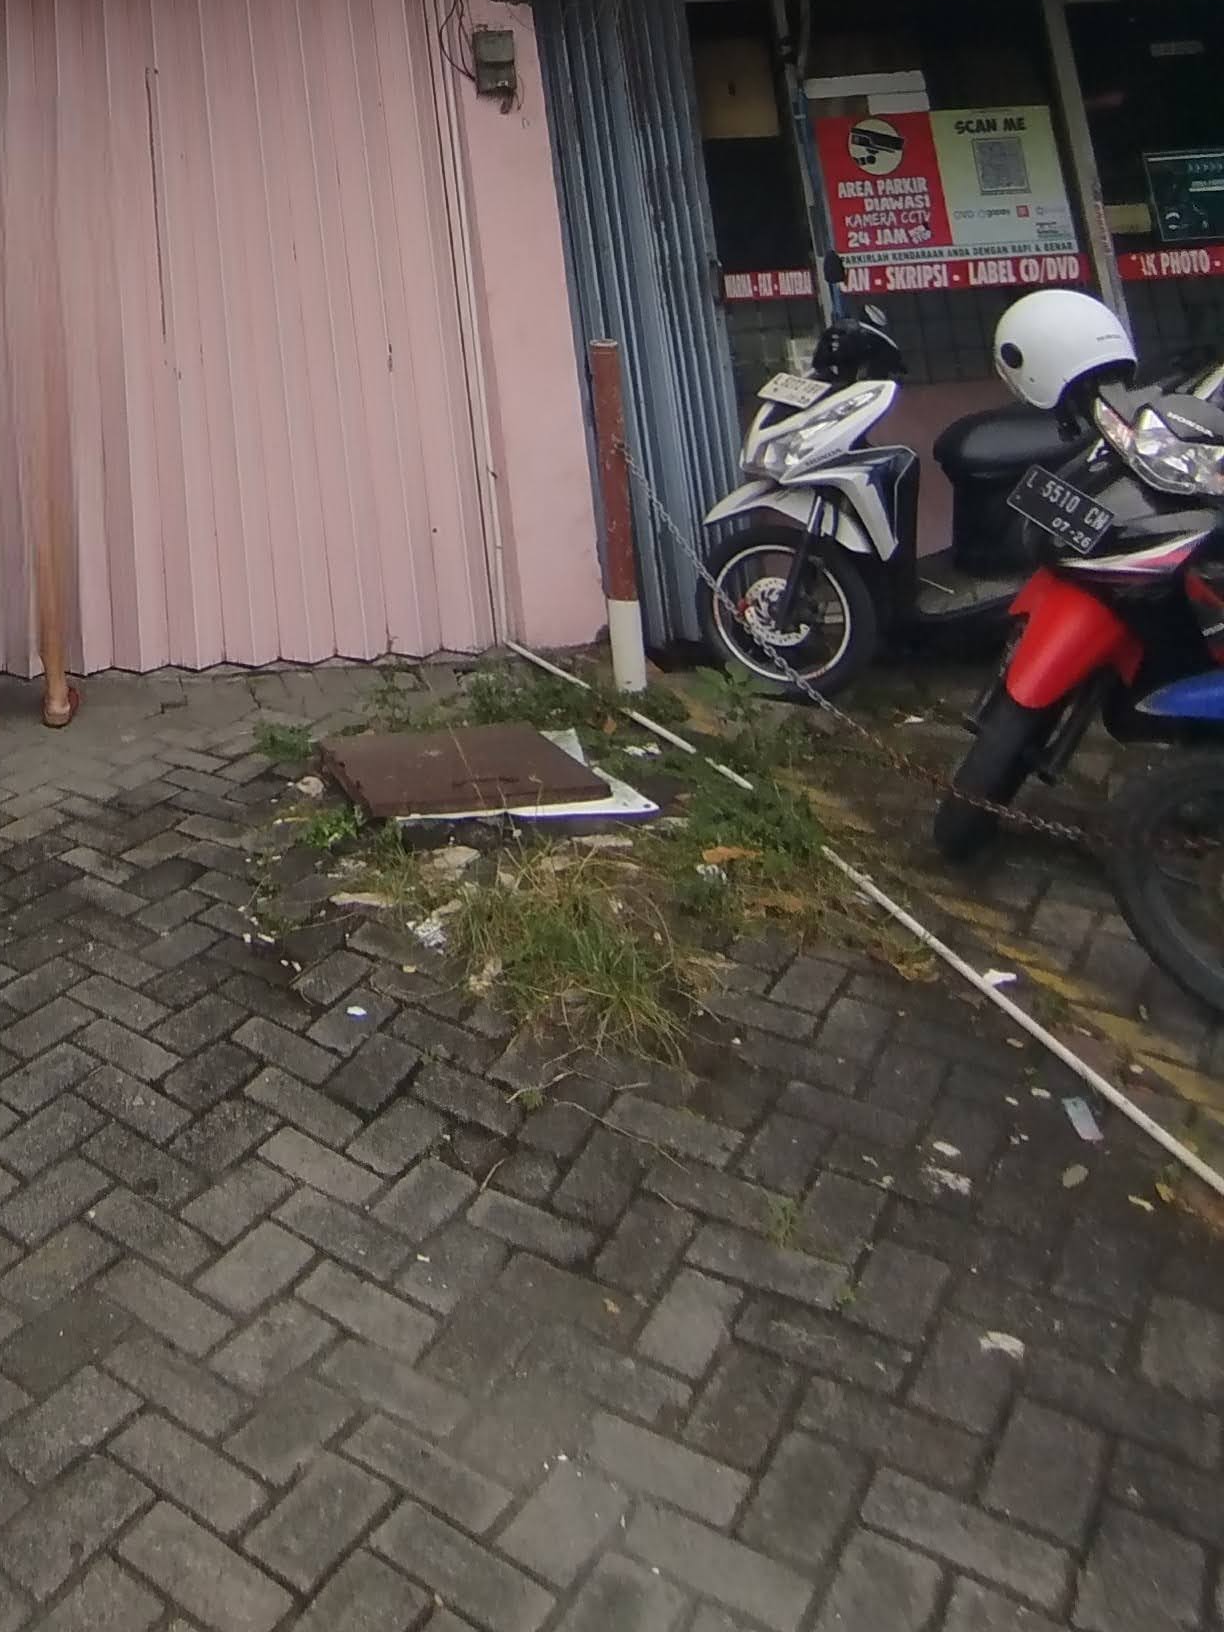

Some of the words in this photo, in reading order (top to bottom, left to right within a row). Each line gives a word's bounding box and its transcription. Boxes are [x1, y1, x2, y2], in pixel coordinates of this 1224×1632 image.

[955, 119, 997, 135] SCAN
[1003, 116, 1027, 132] ME
[837, 180, 874, 199] AREA
[876, 177, 929, 196] PARKIR
[864, 194, 931, 212] DIAWASI
[844, 211, 897, 228] KAMERA
[900, 210, 931, 224] CCTV
[847, 231, 871, 248] 24
[874, 228, 910, 246] JAM
[1160, 249, 1211, 276] PHOTO
[885, 263, 949, 291] SKRIPSI
[967, 260, 1017, 287] LABEL
[1019, 256, 1081, 283] CD/DVD
[1041, 480, 1081, 514] 5510
